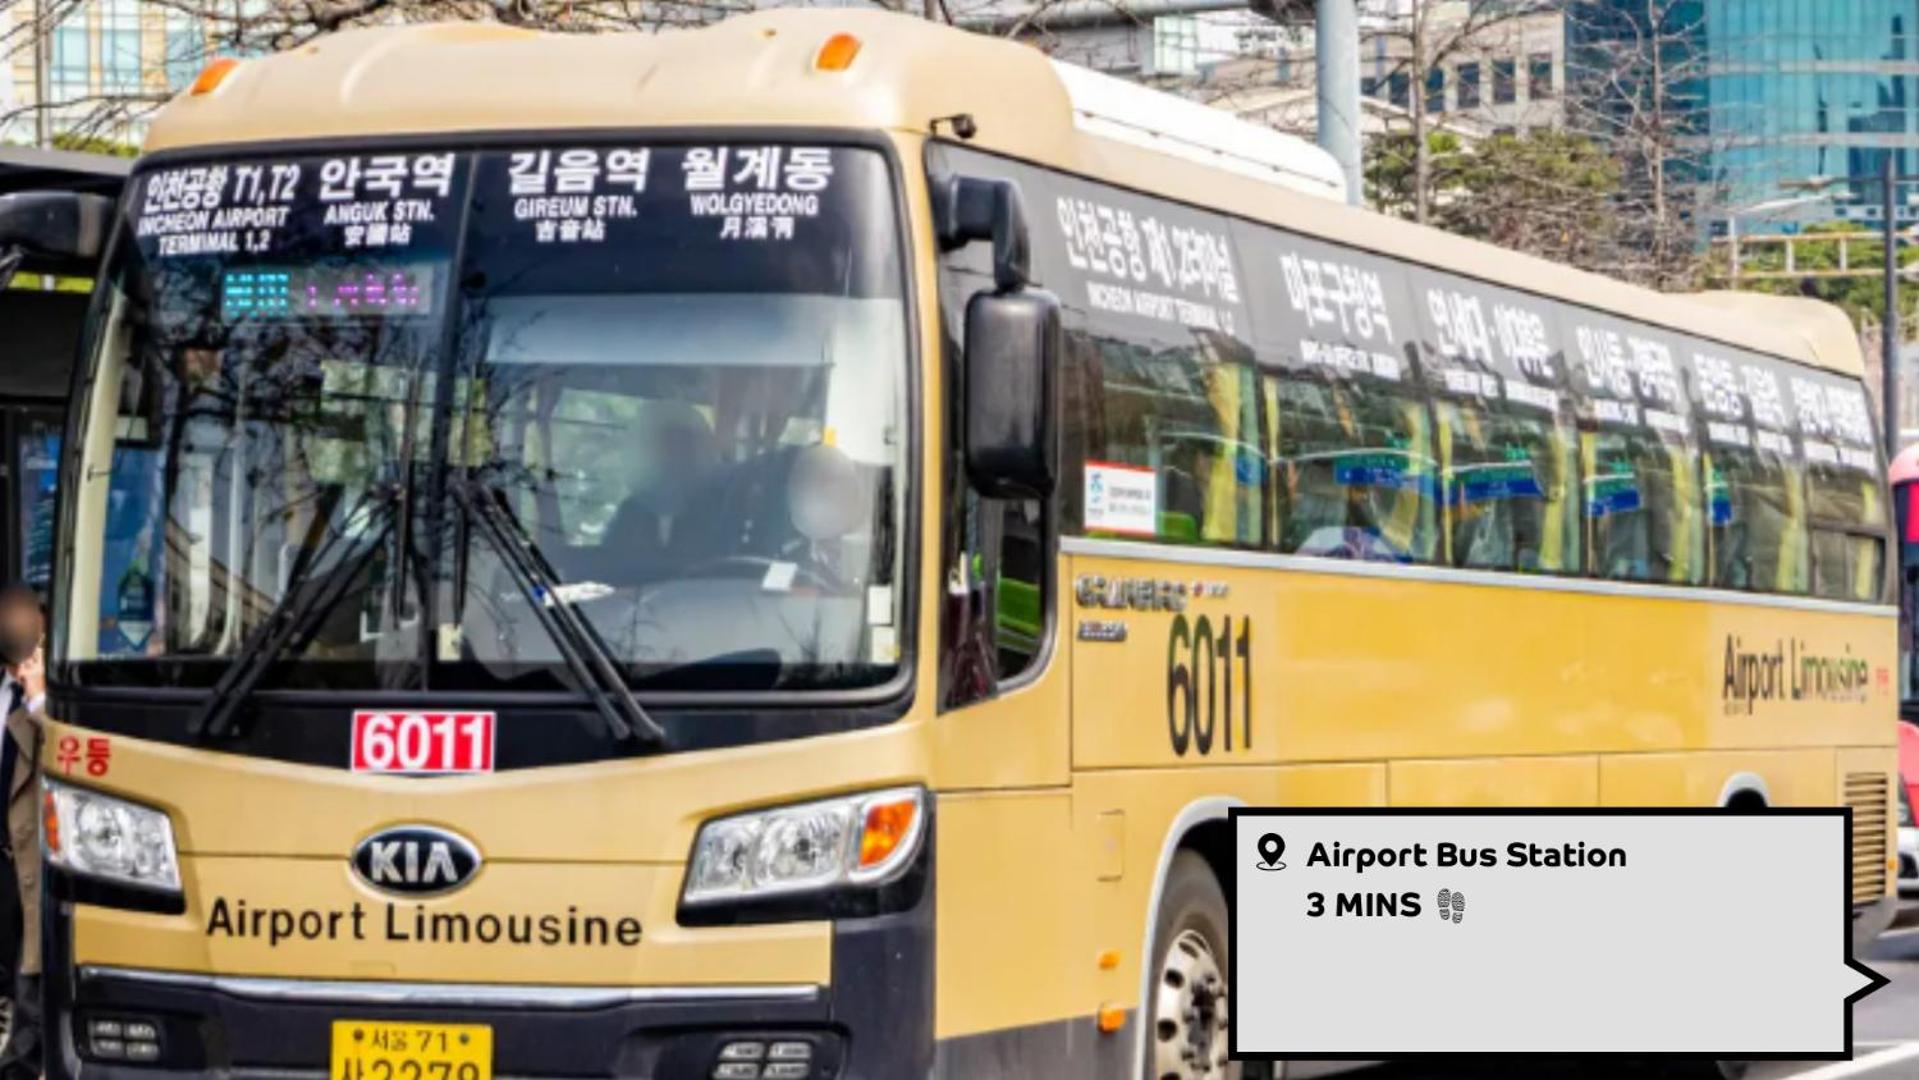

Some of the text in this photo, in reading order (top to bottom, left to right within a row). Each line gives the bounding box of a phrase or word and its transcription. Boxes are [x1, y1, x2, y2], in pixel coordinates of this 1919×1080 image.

[145, 163, 300, 214] 인천공항 T1,T2
[318, 153, 455, 200] 안국역
[508, 147, 650, 194] 길음역
[681, 146, 834, 190] 월계동
[138, 206, 290, 236] INCHEON AIRPORT
[324, 200, 435, 225] ANGUK STN.
[514, 196, 638, 220] GIREUM STN.
[690, 194, 819, 216] WOLGYEDONG
[159, 233, 239, 256] TERMINAL
[1056, 197, 1146, 283] 인천공항
[1280, 251, 1392, 343] 마포구청역
[1168, 614, 1252, 756] 6011
[1723, 634, 1868, 716] Airport Limousine
[57, 735, 110, 777] 우등
[363, 715, 489, 770] 6011
[370, 842, 458, 883] KIA
[207, 897, 643, 946] Airport Limousine
[417, 1030, 447, 1053] 71
